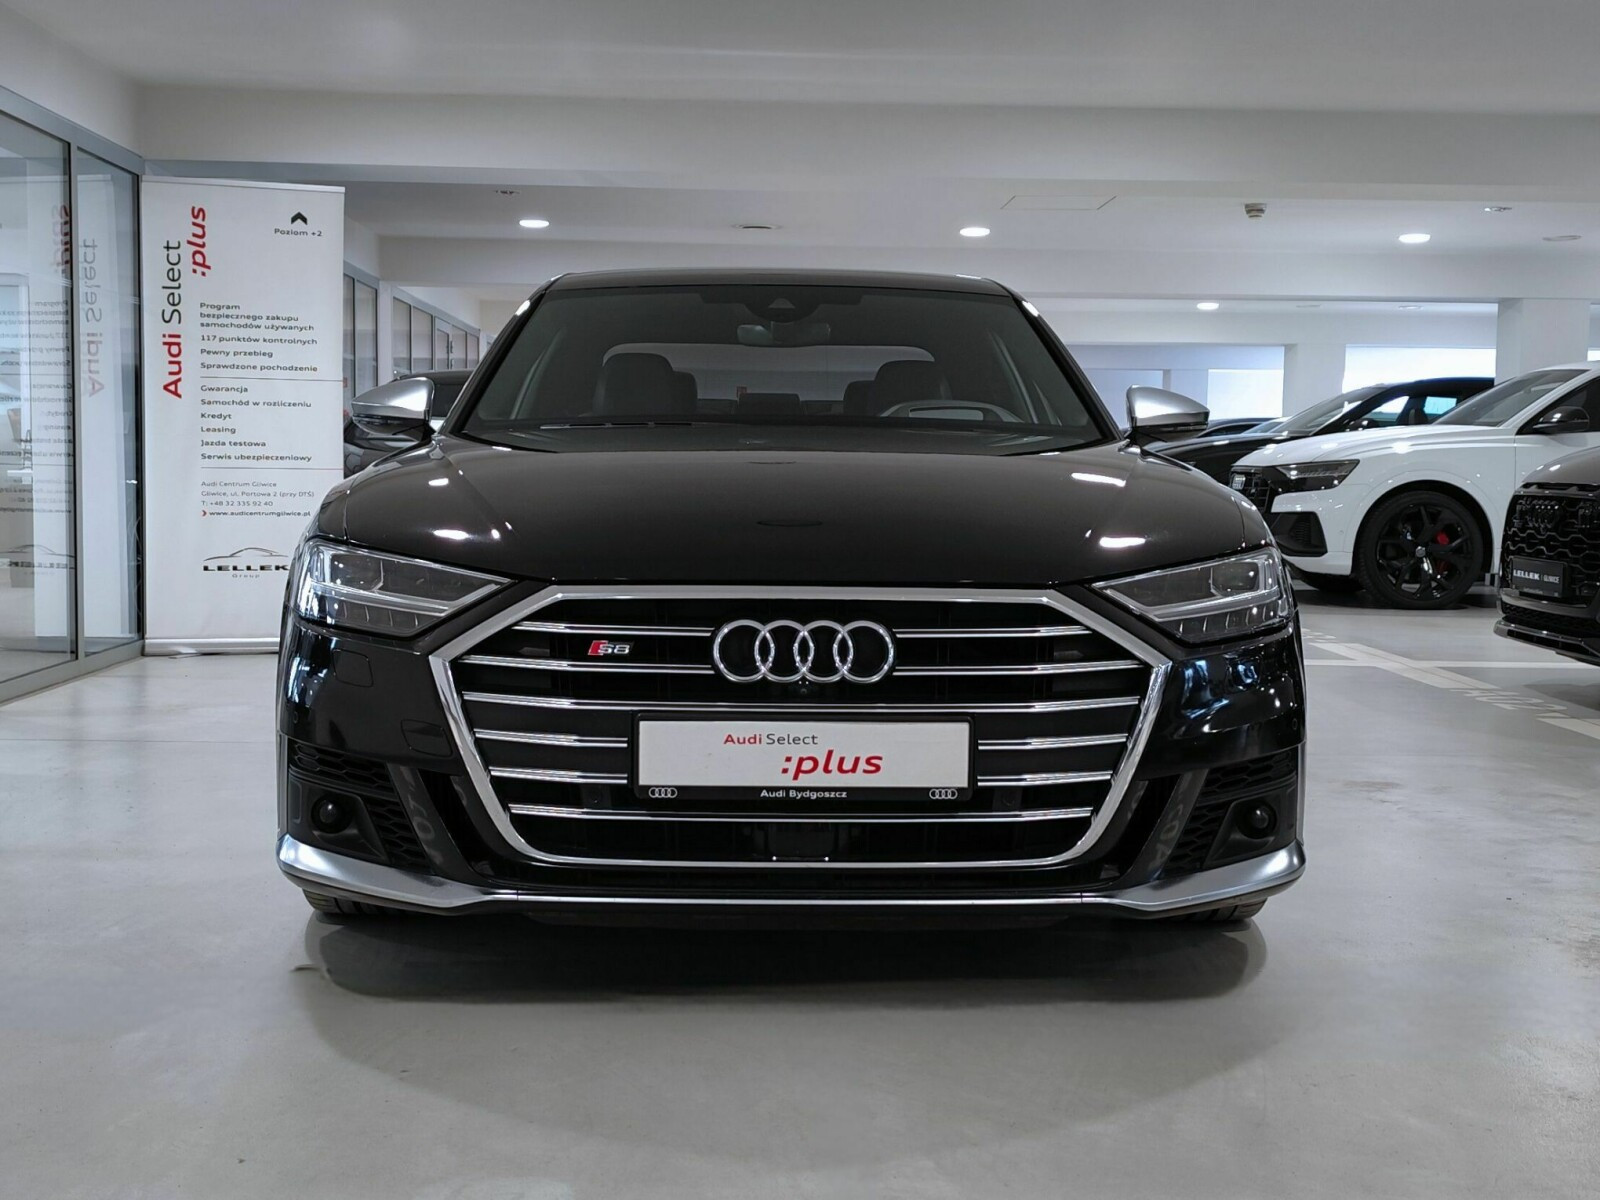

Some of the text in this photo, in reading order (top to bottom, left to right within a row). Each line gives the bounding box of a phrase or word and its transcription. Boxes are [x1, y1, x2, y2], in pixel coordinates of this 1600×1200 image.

[274, 228, 308, 236] Poziom
[187, 206, 211, 277] :plus
[200, 302, 240, 311] Program
[162, 240, 182, 399] Audi Select
[200, 312, 299, 322] bezpiecznego zakupu
[200, 322, 315, 332] samochodów używanych
[219, 335, 260, 344] punktów
[262, 337, 318, 346] kontrolnych
[200, 348, 274, 358] Pewny przebieg
[200, 362, 318, 372] Sprawdzone pochodzenie
[200, 385, 248, 394] Gwarancja
[200, 399, 250, 407] Samochód
[263, 400, 312, 408] rozliczeniu
[200, 412, 232, 421] Kredyt
[200, 426, 237, 435] Leasing
[200, 439, 226, 447] Jazda
[200, 453, 312, 463] Serwis ubezpieczeniowy
[241, 490, 271, 498] Portowa
[209, 510, 311, 518] www.audicentrumgliwice.pl
[203, 564, 290, 572] LELLEK
[1513, 569, 1540, 580] LELLEK
[594, 642, 631, 655] S8
[723, 733, 818, 745] Audi Select
[781, 749, 883, 781] :plus
[760, 789, 848, 800] Audi Bydgoszcz
